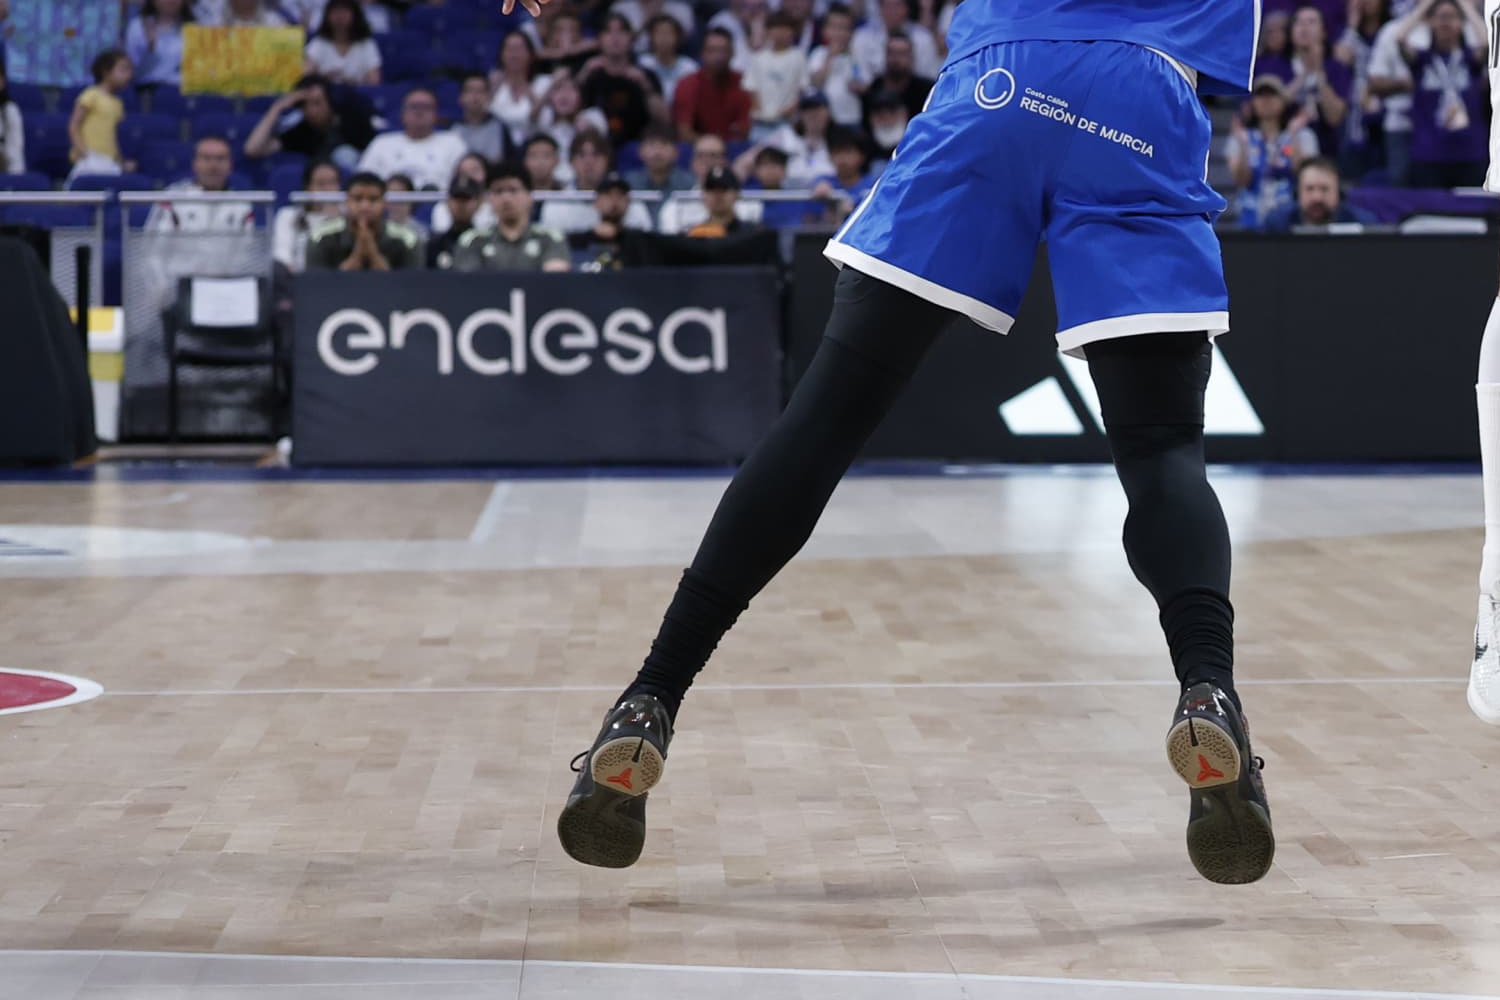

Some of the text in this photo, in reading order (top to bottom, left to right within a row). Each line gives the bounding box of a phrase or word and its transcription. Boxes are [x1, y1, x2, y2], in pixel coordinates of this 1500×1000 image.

[1025, 87, 1046, 100] Costa
[1020, 96, 1154, 159] REGIÓN DE MURCIA
[317, 288, 728, 376] endesa
